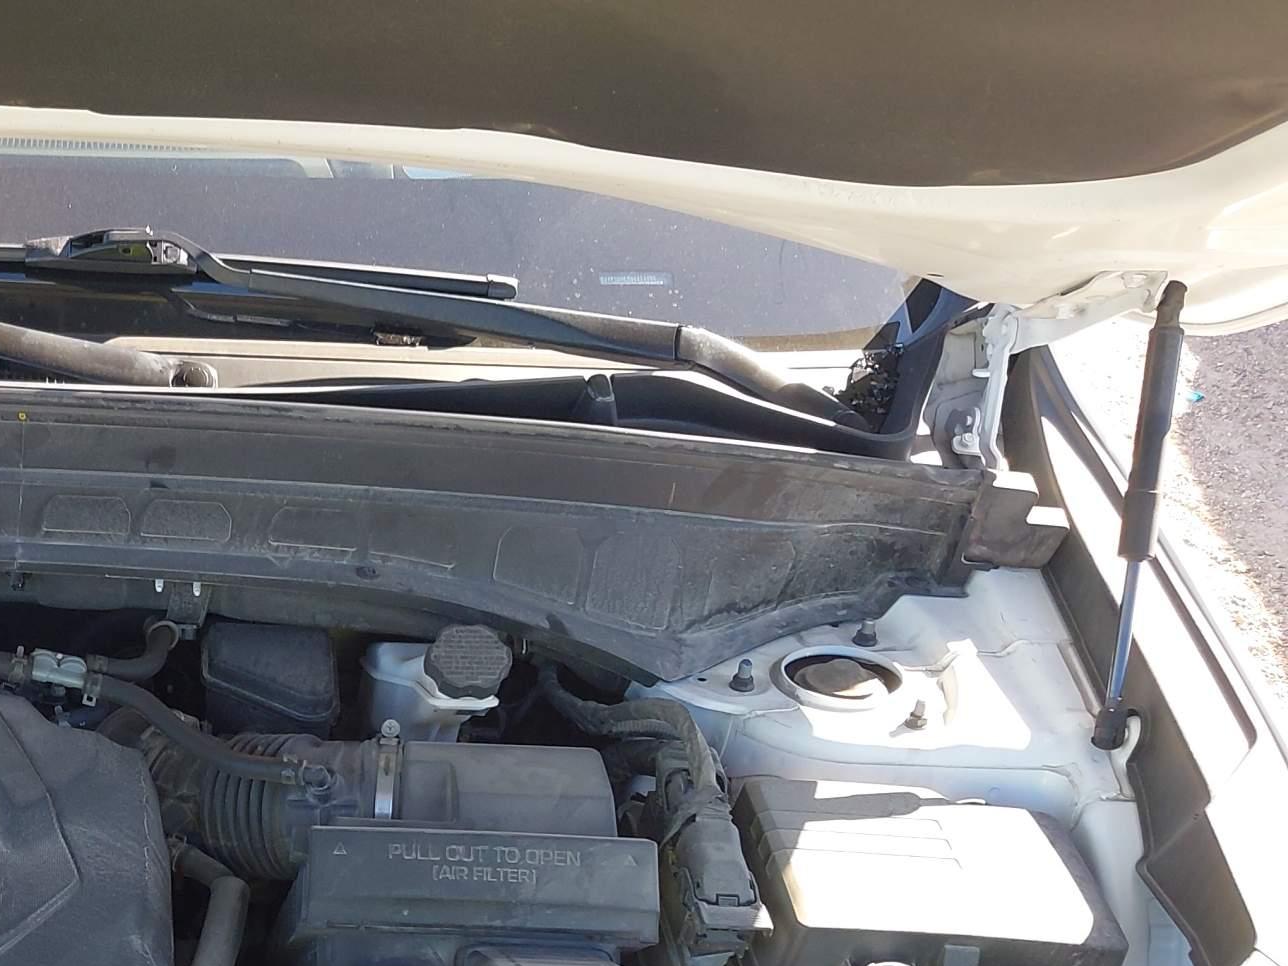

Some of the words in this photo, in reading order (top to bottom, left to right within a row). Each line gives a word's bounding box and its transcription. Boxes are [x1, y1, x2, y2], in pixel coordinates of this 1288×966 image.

[389, 843, 441, 861] PULL
[445, 845, 488, 862] OUT
[492, 847, 521, 864] TO
[526, 849, 582, 867] OPEN
